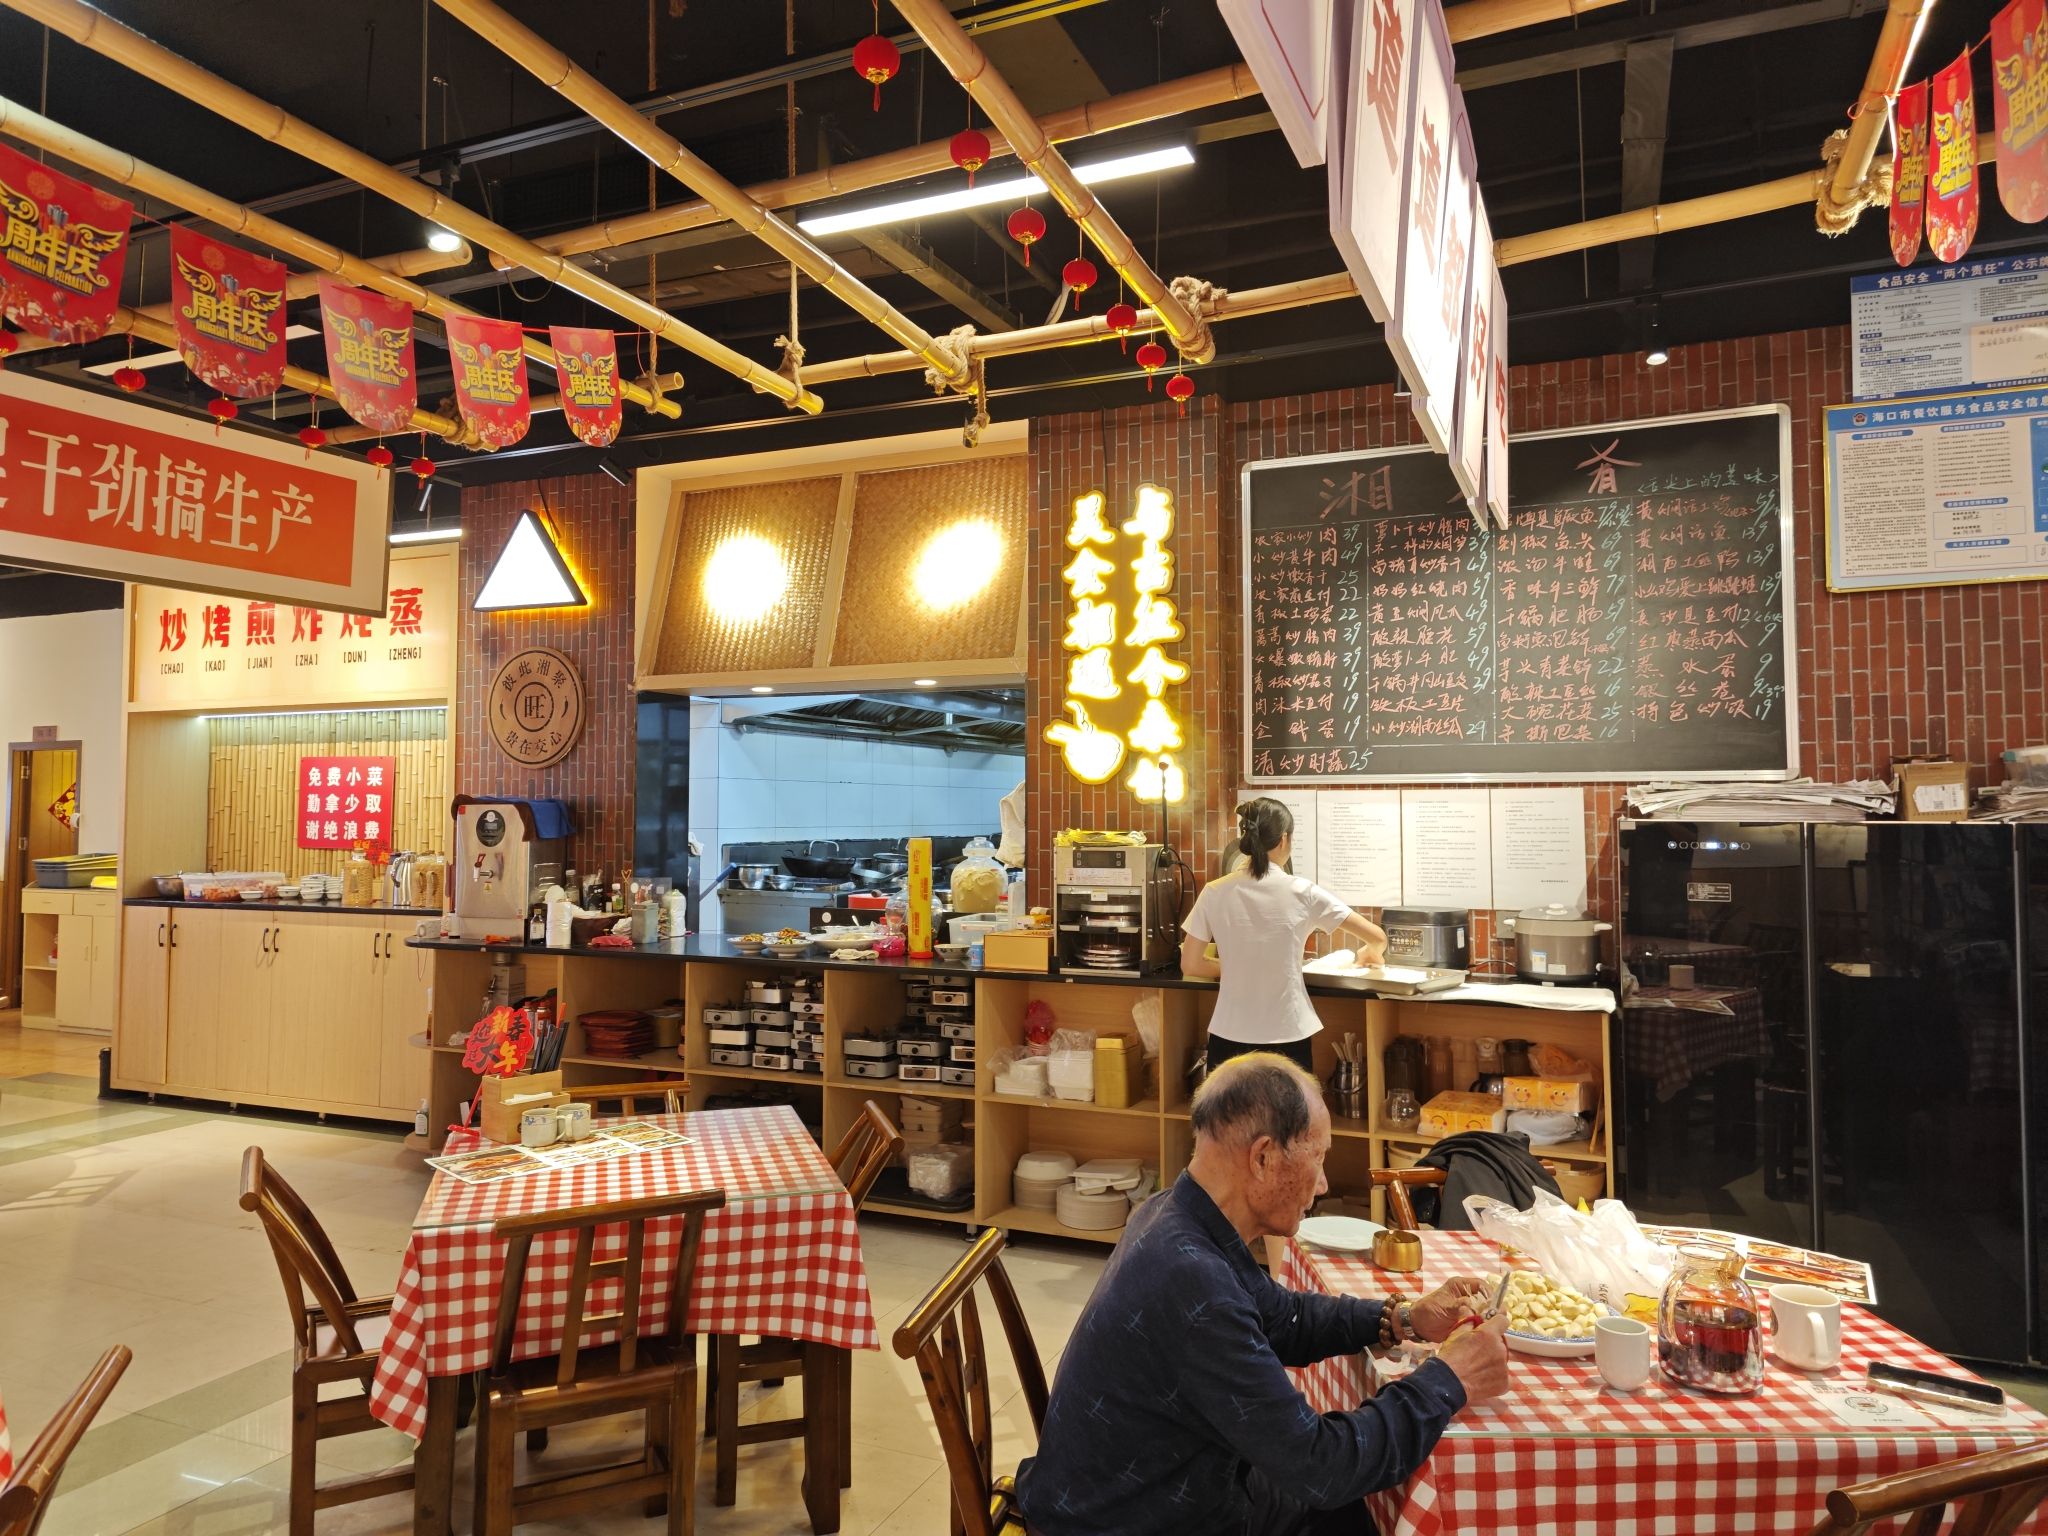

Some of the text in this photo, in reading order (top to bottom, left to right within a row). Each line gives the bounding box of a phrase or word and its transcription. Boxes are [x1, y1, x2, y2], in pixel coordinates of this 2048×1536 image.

[0, 215, 109, 287] 周年庆
[1414, 105, 1441, 275] 道
[1443, 210, 1465, 342] 都
[1471, 288, 1486, 400] 好
[1496, 354, 1506, 438] 吃
[1878, 272, 1929, 288] 食品安全
[182, 289, 277, 342] 周年庆
[333, 337, 408, 377] 周年庆
[460, 364, 522, 395] 周年庆
[566, 373, 616, 397] 周年庆
[1343, 524, 1360, 542] 39
[1469, 531, 1490, 553] 39
[1601, 531, 1623, 550] 69
[1742, 521, 1767, 542] 139
[1341, 543, 1362, 563] 49
[1467, 551, 1487, 572] 49
[1604, 551, 1621, 571] 69
[1747, 544, 1774, 566] 139
[1337, 571, 1359, 585] 25
[1472, 572, 1491, 599] 59
[1607, 574, 1626, 595] 79
[1339, 586, 1362, 601] 22
[1338, 608, 1359, 621] 22
[1466, 599, 1487, 622] 49
[1605, 598, 1626, 622] 59
[1343, 622, 1361, 645] 39
[1464, 622, 1487, 648] 59
[1606, 626, 1627, 650] 69
[1758, 623, 1776, 646] 9
[1343, 647, 1361, 672] 39
[1468, 646, 1489, 671] 49
[1598, 657, 1626, 677] 22
[1755, 653, 1773, 680] 9
[1343, 672, 1359, 691] 19
[1604, 678, 1622, 697] 16
[1343, 693, 1359, 713] 19
[1601, 701, 1623, 720] 25
[1756, 699, 1771, 720] 19
[1344, 715, 1360, 742] 19
[1466, 720, 1487, 741] 29
[1600, 719, 1622, 738] 16
[1349, 750, 1373, 771] 25
[308, 766, 384, 787] 免费小菜
[306, 793, 382, 814] 勤拿少取
[306, 820, 380, 841] 谢绝浪费
